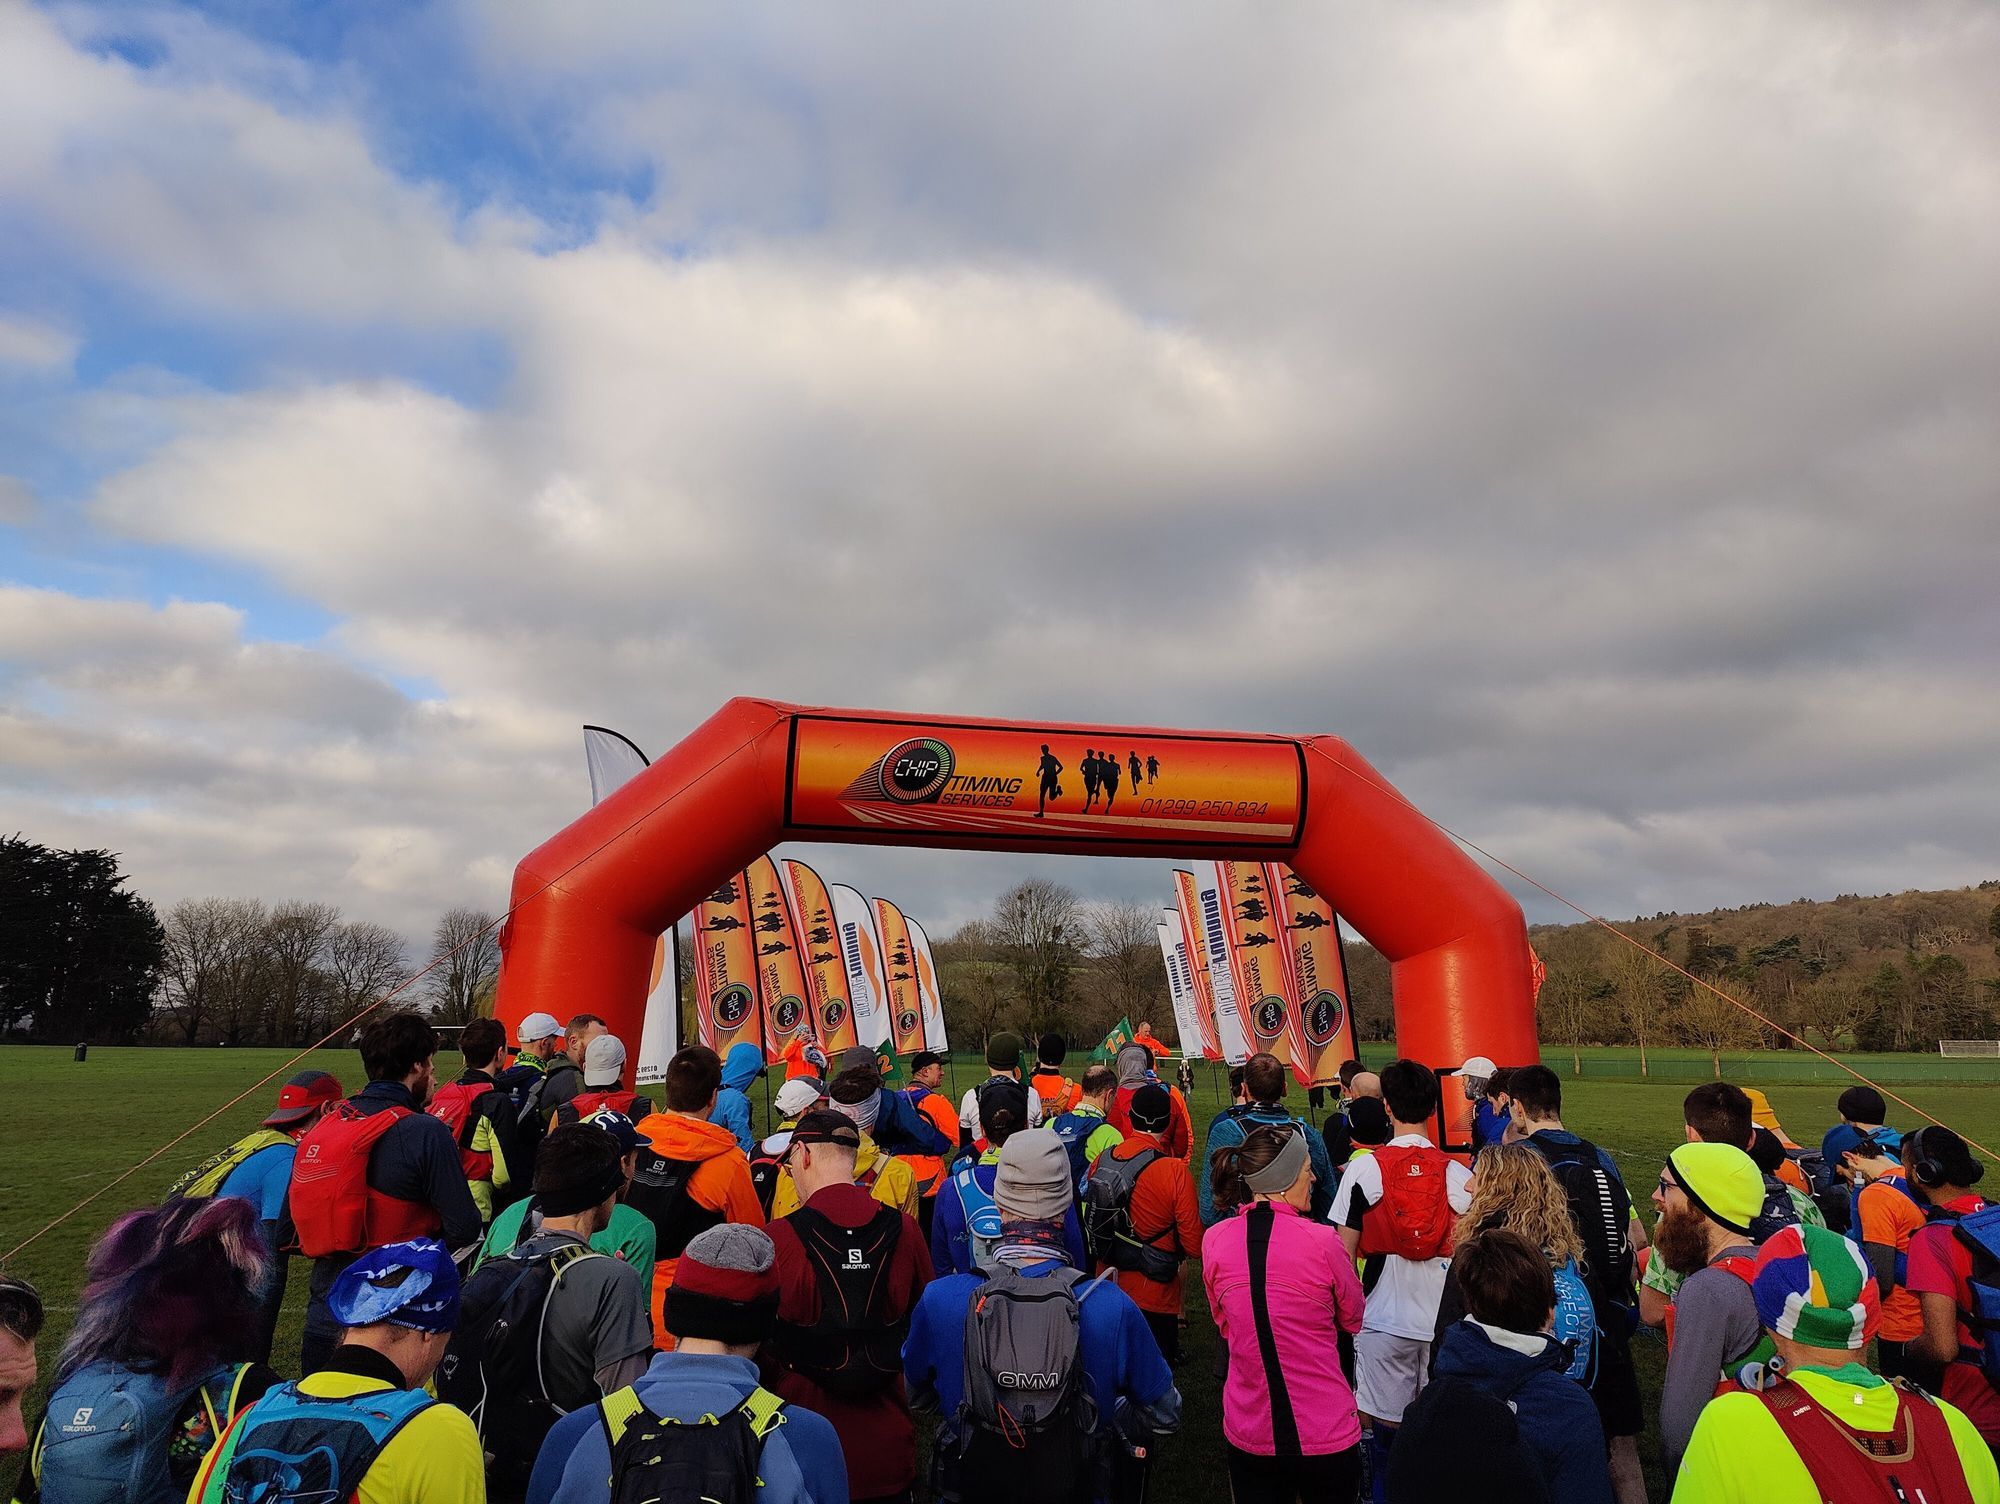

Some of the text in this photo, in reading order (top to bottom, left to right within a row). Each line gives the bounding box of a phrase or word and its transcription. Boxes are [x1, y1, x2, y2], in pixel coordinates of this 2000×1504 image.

[895, 759, 938, 777] CHIP
[949, 775, 1022, 793] TIMING
[941, 793, 1014, 807] SERVICES
[1140, 798, 1268, 817] 01299 250 834
[1106, 1032, 1126, 1055] 11
[877, 1053, 893, 1074] 2
[998, 1371, 1059, 1389] OMM
